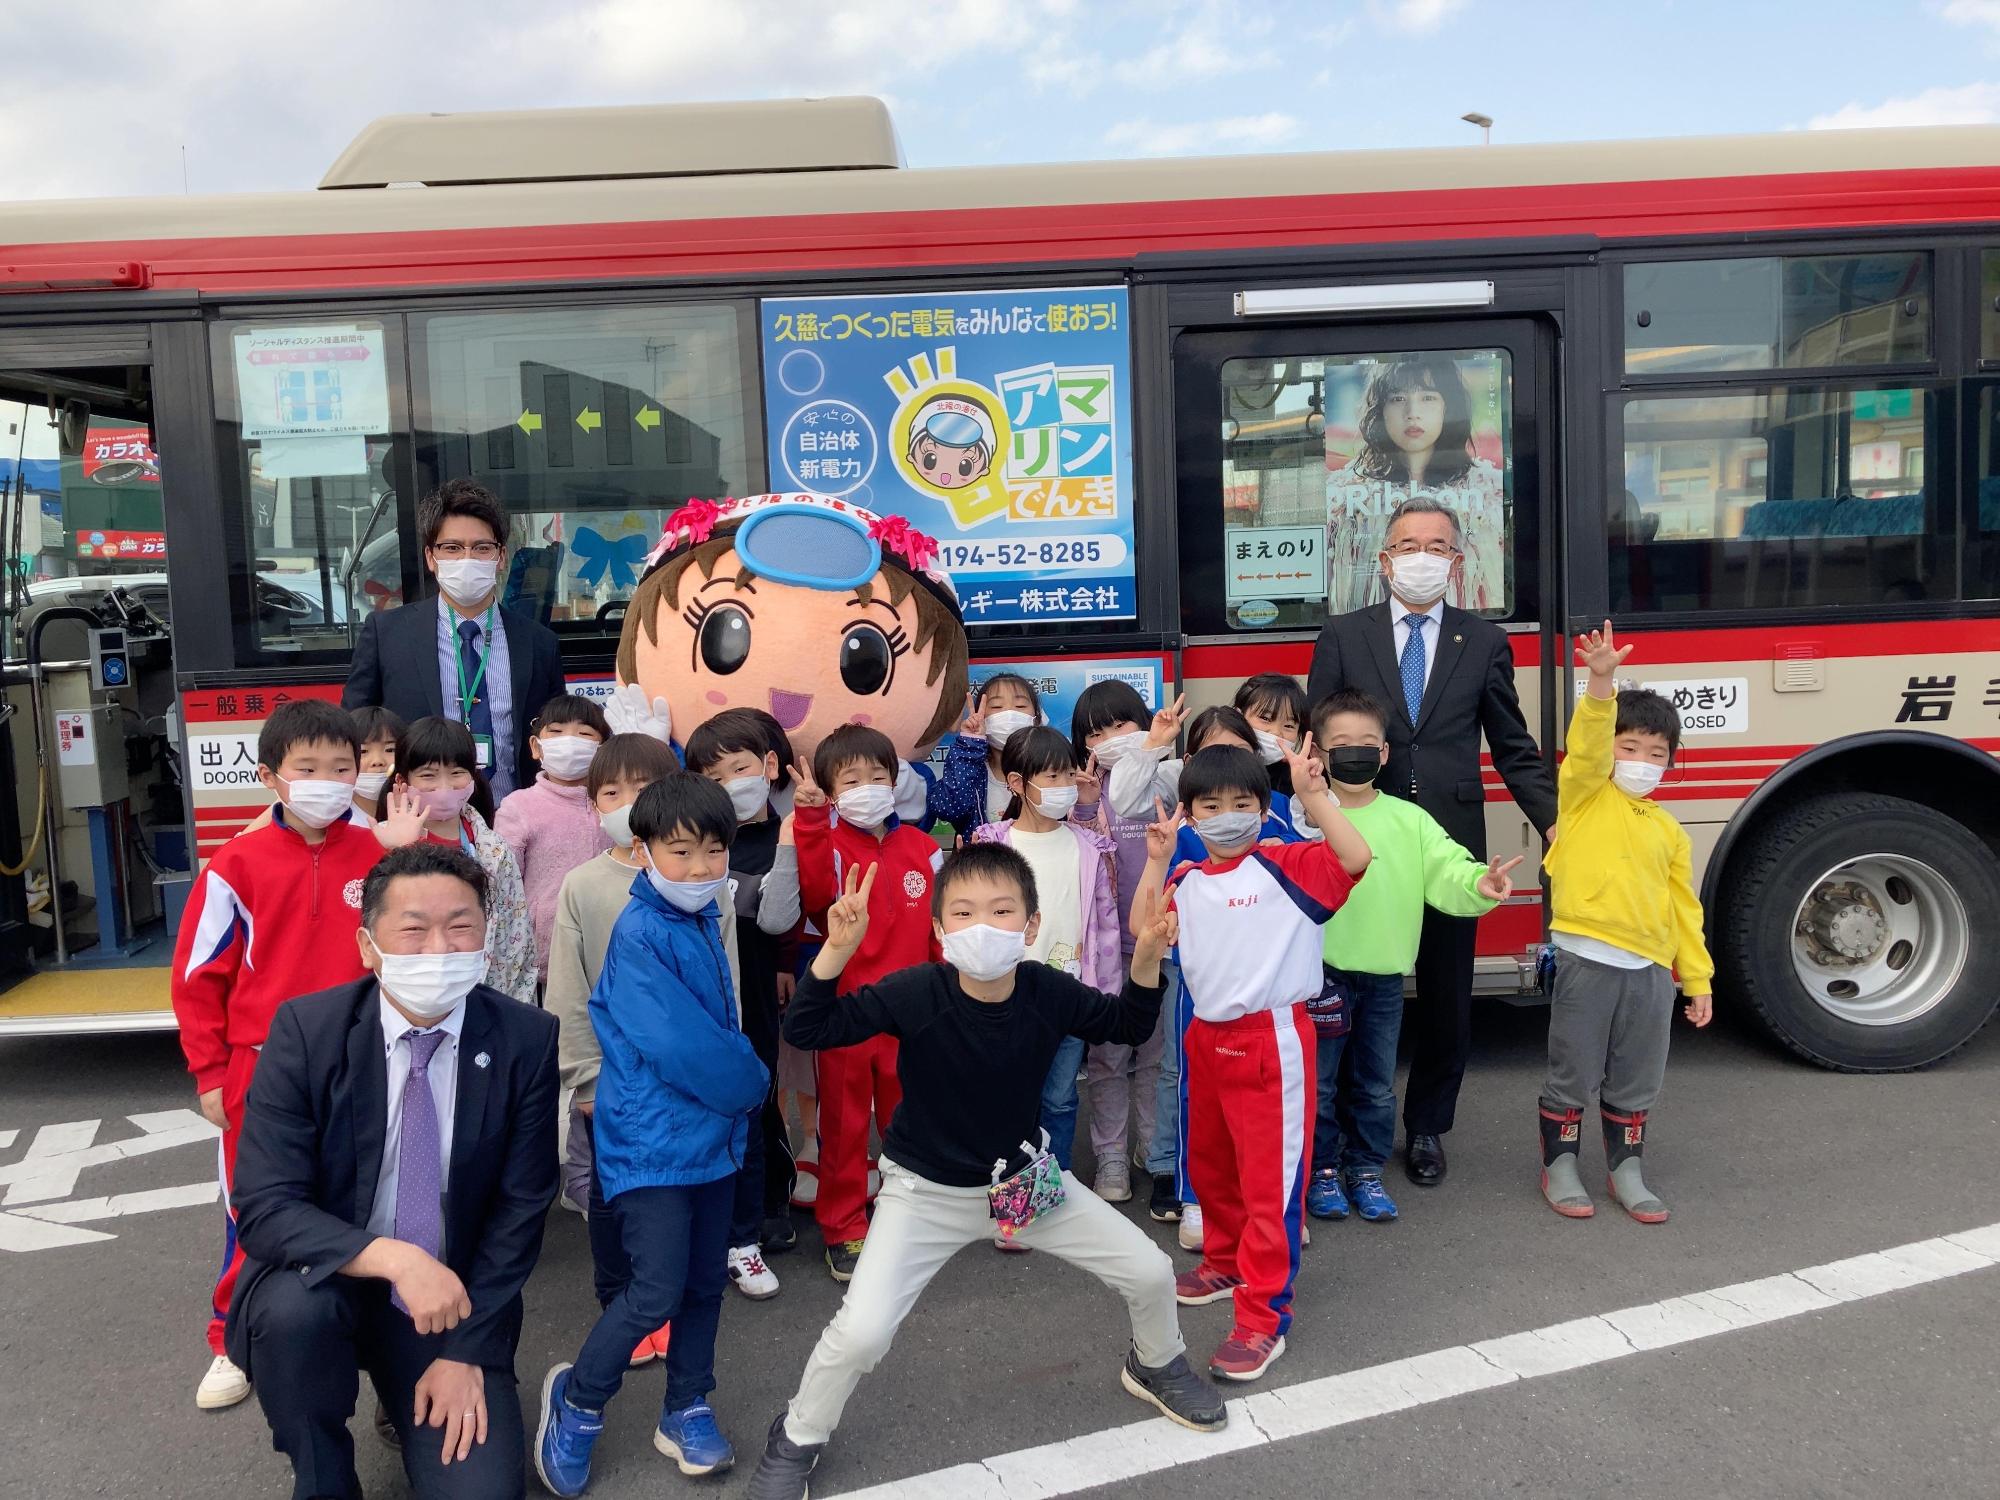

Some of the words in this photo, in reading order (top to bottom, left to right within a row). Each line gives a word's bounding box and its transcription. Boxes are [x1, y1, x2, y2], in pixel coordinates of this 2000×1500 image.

[803, 409, 856, 427] 安心の
[800, 430, 860, 452] 自治体
[800, 458, 861, 479] 新電力
[1008, 478, 1113, 518] でんき
[142, 543, 165, 553] カラ
[942, 541, 1100, 567] 194-52-8285
[1236, 538, 1314, 561] まえのり
[1092, 672, 1148, 682] SUSTAINABLE
[575, 685, 615, 697] のるねっ
[1672, 686, 1737, 711] めきり
[1681, 715, 1726, 729] OSED
[59, 720, 72, 752] 整理券
[200, 741, 256, 766] 出入
[204, 770, 262, 784] DOORW
[1228, 894, 1258, 908] Kuji
